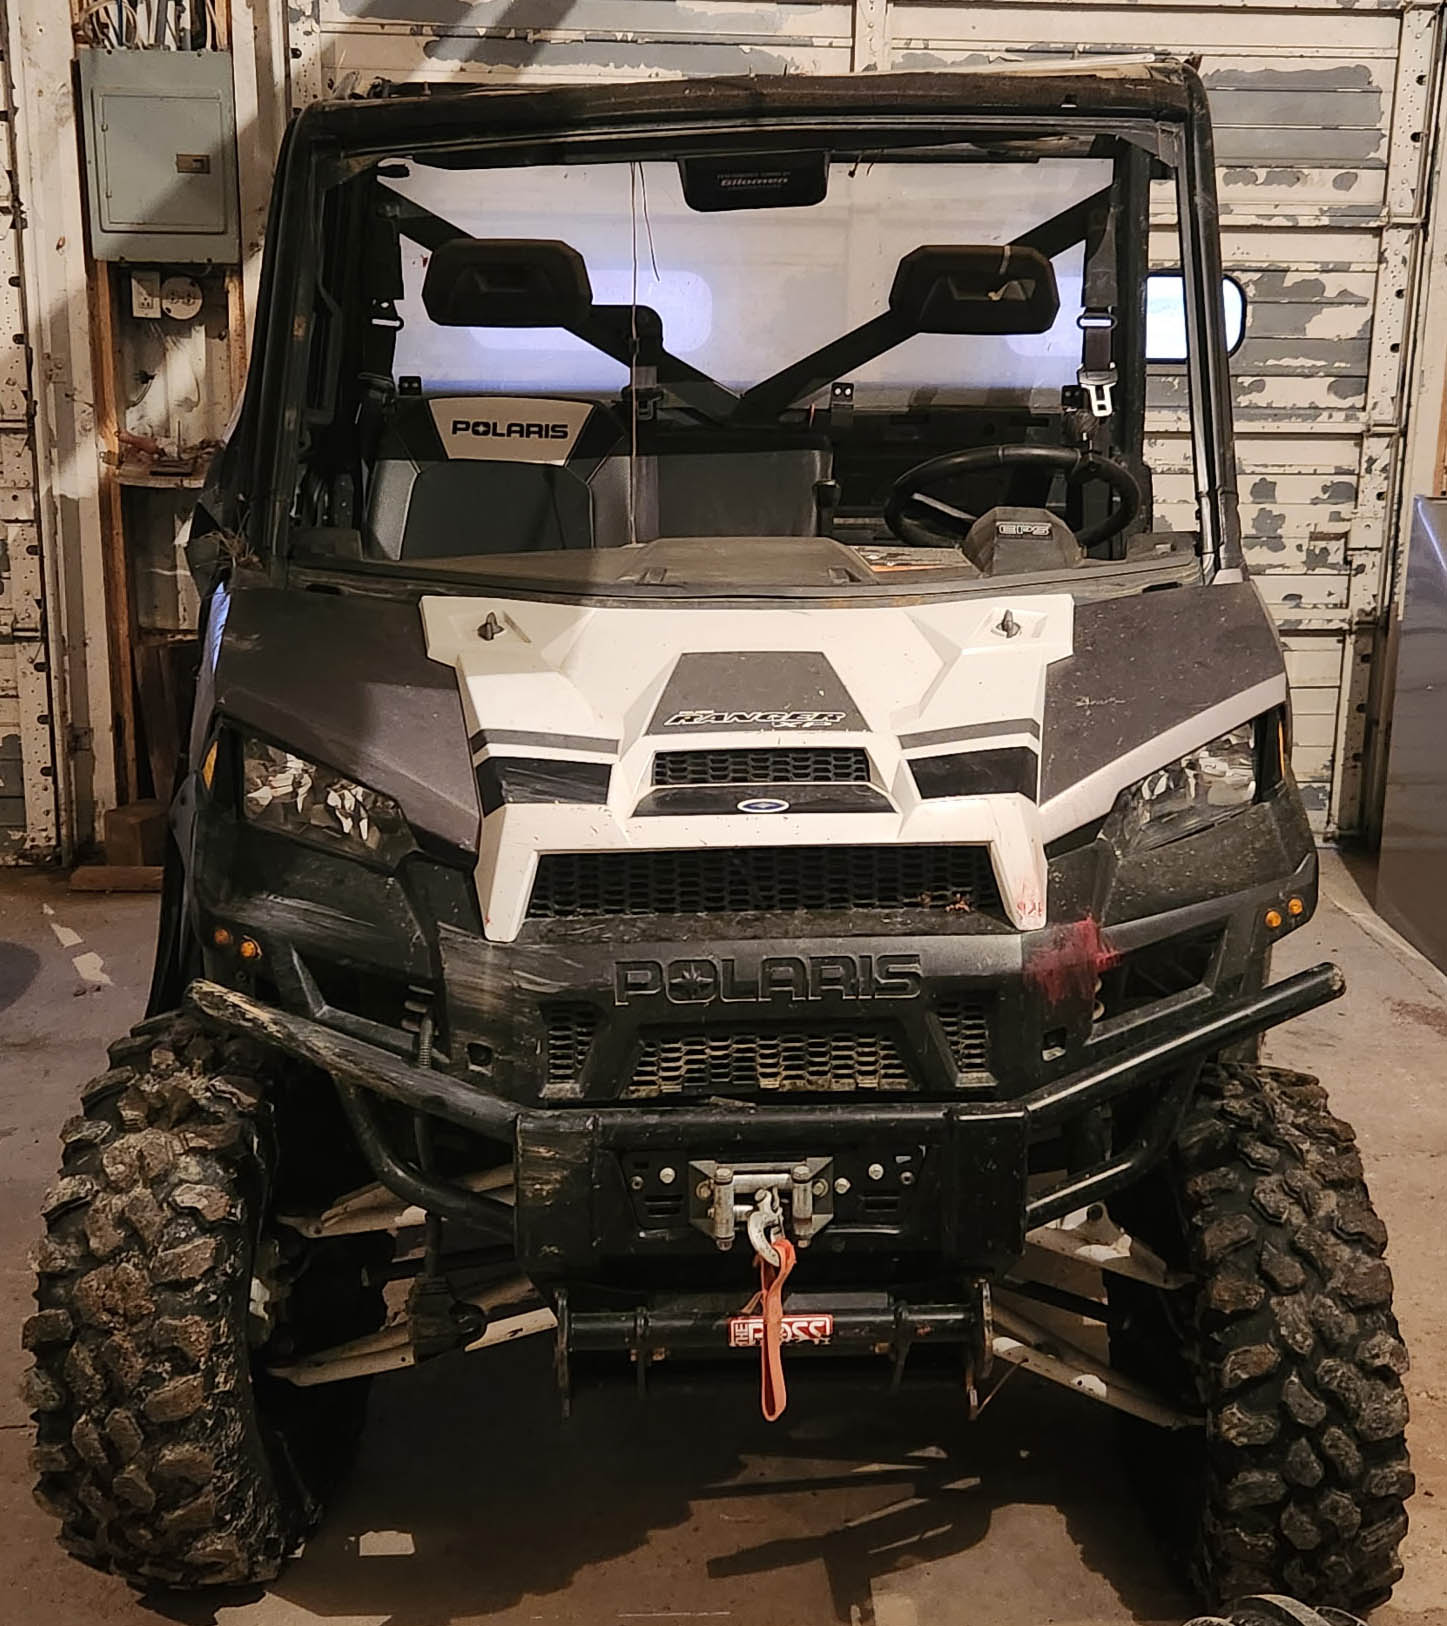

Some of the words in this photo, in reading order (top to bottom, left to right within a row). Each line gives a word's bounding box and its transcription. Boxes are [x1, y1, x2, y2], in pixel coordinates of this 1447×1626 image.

[451, 420, 569, 440] POLARIS
[997, 523, 1051, 536] EPS
[663, 711, 847, 726] RANGER
[773, 720, 833, 728] XP
[614, 953, 922, 1006] POLARIS
[735, 1323, 748, 1345] THE
